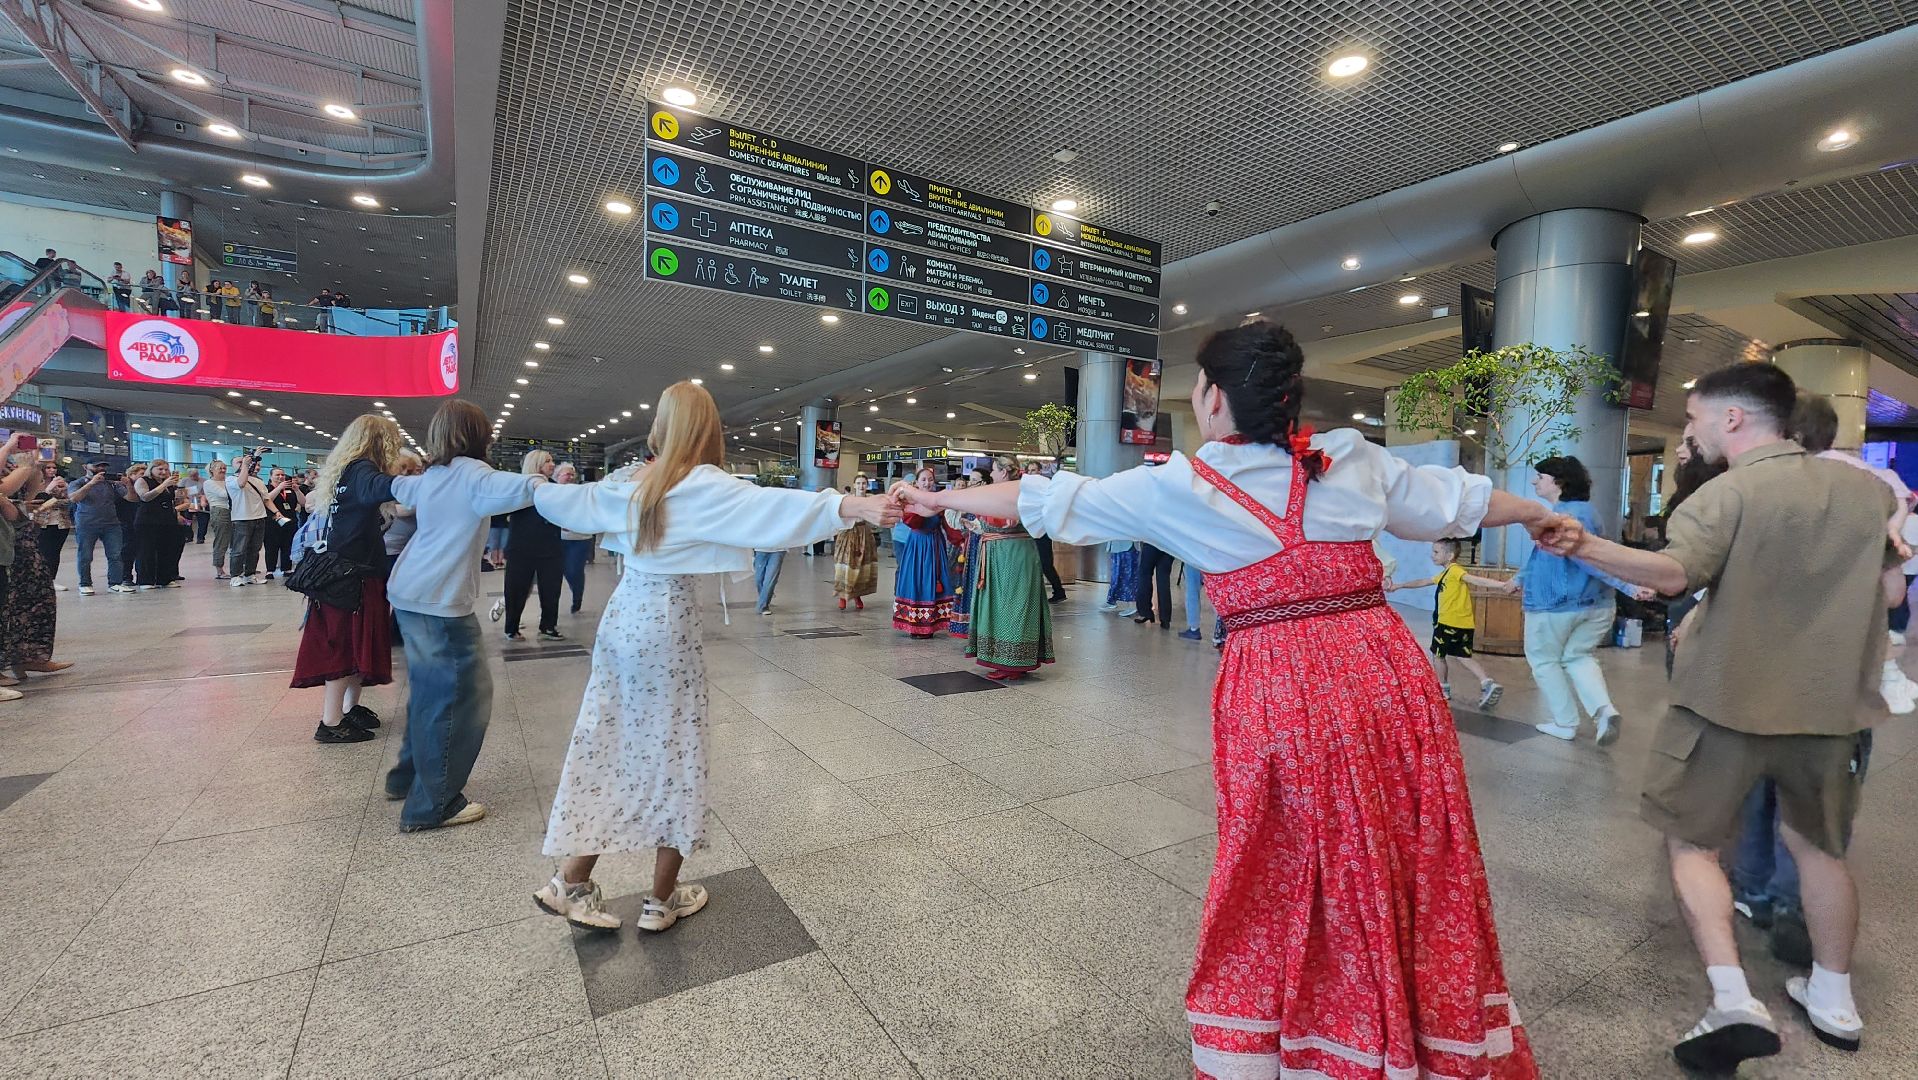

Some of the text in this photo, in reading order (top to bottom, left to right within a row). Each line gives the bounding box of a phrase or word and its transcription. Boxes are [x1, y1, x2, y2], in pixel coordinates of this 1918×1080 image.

[729, 129, 757, 143] ВЫЛЕТ
[771, 140, 777, 148] D
[729, 139, 828, 172] ВНУТРЕННИЕ АВИАЛИНИИ
[729, 149, 810, 177] DOMESTIC DEPARTURES
[729, 173, 812, 200] ОБСЛУЖИВАНИЕ ЛИЦ
[928, 183, 953, 196] ПРИЛЕТ
[729, 194, 788, 213] PRM ASSISTANCE
[730, 183, 862, 220] С ОГРАНИЧЕННОЙ ПОДВИЖНОСТЬЮ
[928, 192, 1004, 219] ВНУТРЕННИЕ АВИАЛИНИИ
[928, 200, 982, 221] DOMESTIC ARRIVALS
[729, 221, 774, 240] АПТЕКА
[927, 221, 991, 243] ПРЕДСТАВИТЕЛЬСТВА
[729, 236, 769, 251] PHARMACY
[927, 230, 978, 248] АВИАКОМПАНИЙ
[927, 238, 972, 255] AIRLINE OFFICES
[1080, 233, 1123, 249] МЕЖДУНАРОДНЫЕ
[1080, 241, 1113, 254] INTERNATIONAL
[926, 259, 957, 272] КОМНАТА
[1080, 261, 1153, 284] ВЕТЕРИНАРНЫЙ КОНТРОЛЬ
[779, 272, 819, 290] ТУАЛЕТ
[926, 268, 984, 286] МАТЕРИ И РЕБЕНКА
[926, 276, 940, 285] BABY
[941, 279, 955, 288] CARE
[956, 282, 973, 292] ROOM
[1106, 278, 1125, 289] CONTROL
[779, 288, 803, 298] TOILET
[1078, 294, 1106, 308] МЕЧЕТЬ
[925, 300, 965, 316] ВЫХОД 3
[971, 308, 996, 320] Яндекс
[1078, 306, 1097, 316] MOSQUE
[925, 314, 937, 322] EXIT
[971, 322, 983, 330] TAXI
[1076, 327, 1115, 341] МЕДПУНКТ
[127, 341, 168, 354] АВТО
[1076, 340, 1096, 348] MEDICAL
[1096, 342, 1115, 351] SERVICES
[139, 352, 190, 364] РАДИО
[112, 370, 124, 378] 0+
